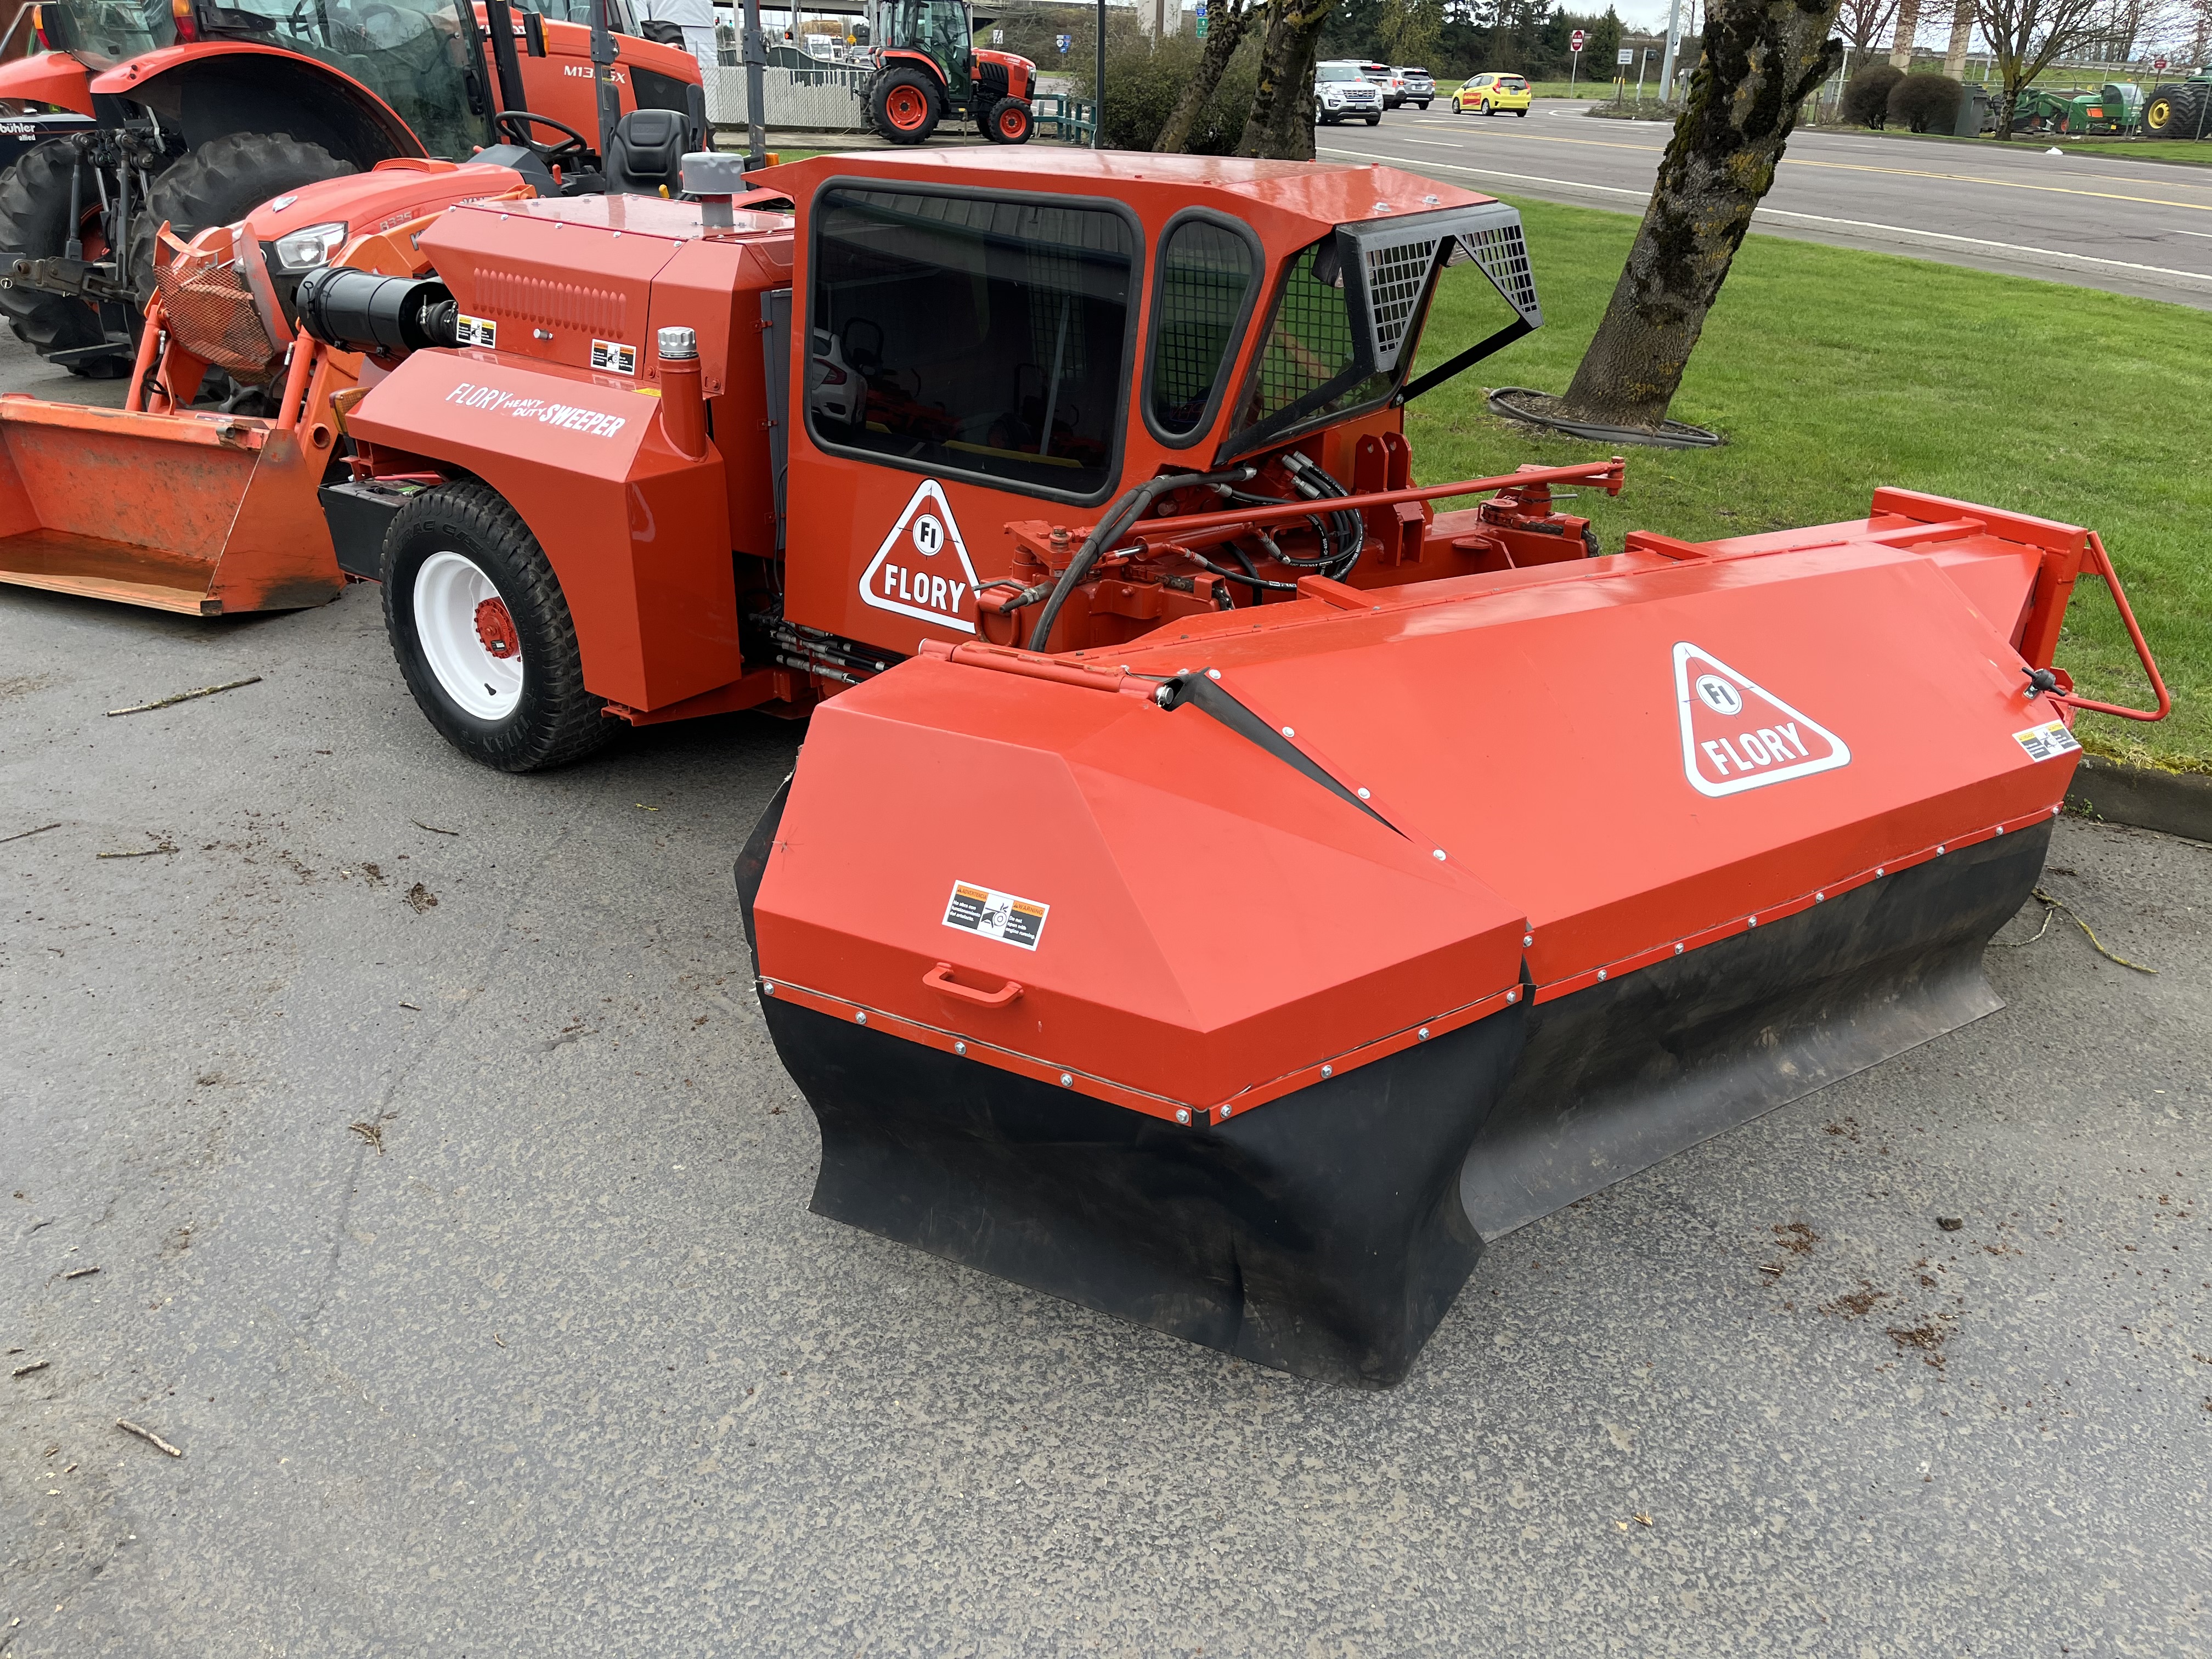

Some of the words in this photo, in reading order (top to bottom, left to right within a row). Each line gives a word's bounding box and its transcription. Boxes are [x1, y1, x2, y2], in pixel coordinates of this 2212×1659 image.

[564, 65, 625, 84] M13X
[0, 123, 35, 133] bühler
[445, 382, 514, 411] FLORY
[504, 399, 545, 409] HEAVY
[512, 407, 548, 417] DUTY
[539, 404, 626, 438] SWEEPER
[884, 562, 967, 613] FLORY
[1700, 721, 1810, 776] FLORY
[1018, 904, 1043, 915] WARNING
